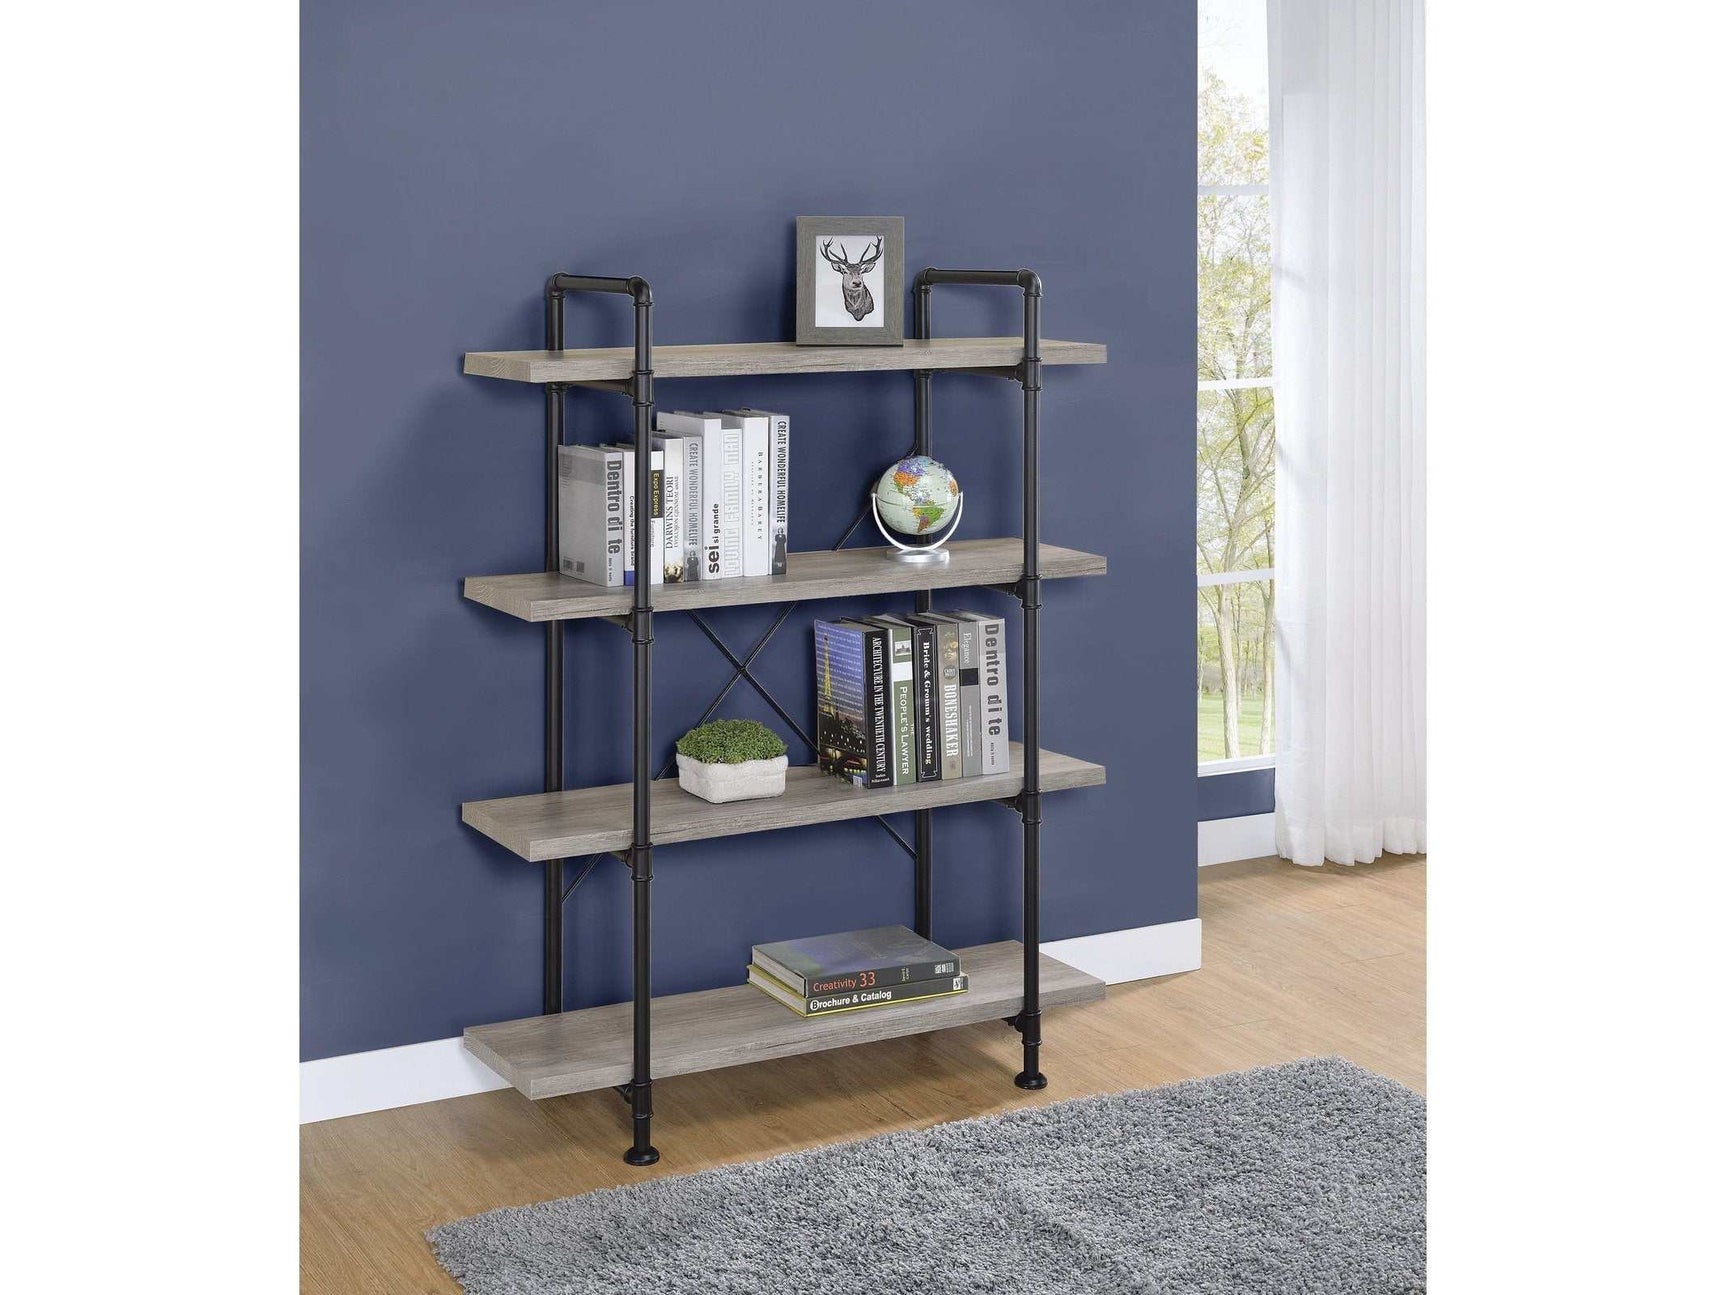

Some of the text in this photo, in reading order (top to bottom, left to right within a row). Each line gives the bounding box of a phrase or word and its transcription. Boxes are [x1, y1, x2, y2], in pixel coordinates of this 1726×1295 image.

[776, 420, 787, 523] CREATE WONDERFUL HOMELIFE
[606, 460, 623, 554] Dentro di te
[688, 442, 698, 547] CREATE WONDERFUL HOMELIFE
[665, 476, 674, 549] DARWINS TEORI
[704, 503, 721, 574] sei si grande
[922, 641, 931, 669] Bride
[962, 632, 972, 664] Elegance
[984, 624, 1000, 687] Dentro
[873, 685, 883, 693] IN
[923, 669, 931, 679] &
[874, 692, 884, 706] THE
[987, 695, 1002, 713] di
[875, 707, 885, 744] TWENTIETH
[899, 686, 910, 775] PEOPLE'S LAWYER
[944, 684, 959, 757] BONESHAKER
[988, 718, 1002, 737] te
[876, 743, 886, 773] CENTURY
[924, 726, 933, 765] wedding
[812, 971, 876, 992] Creativity 33
[810, 989, 892, 1011] Brochure & Catalog
